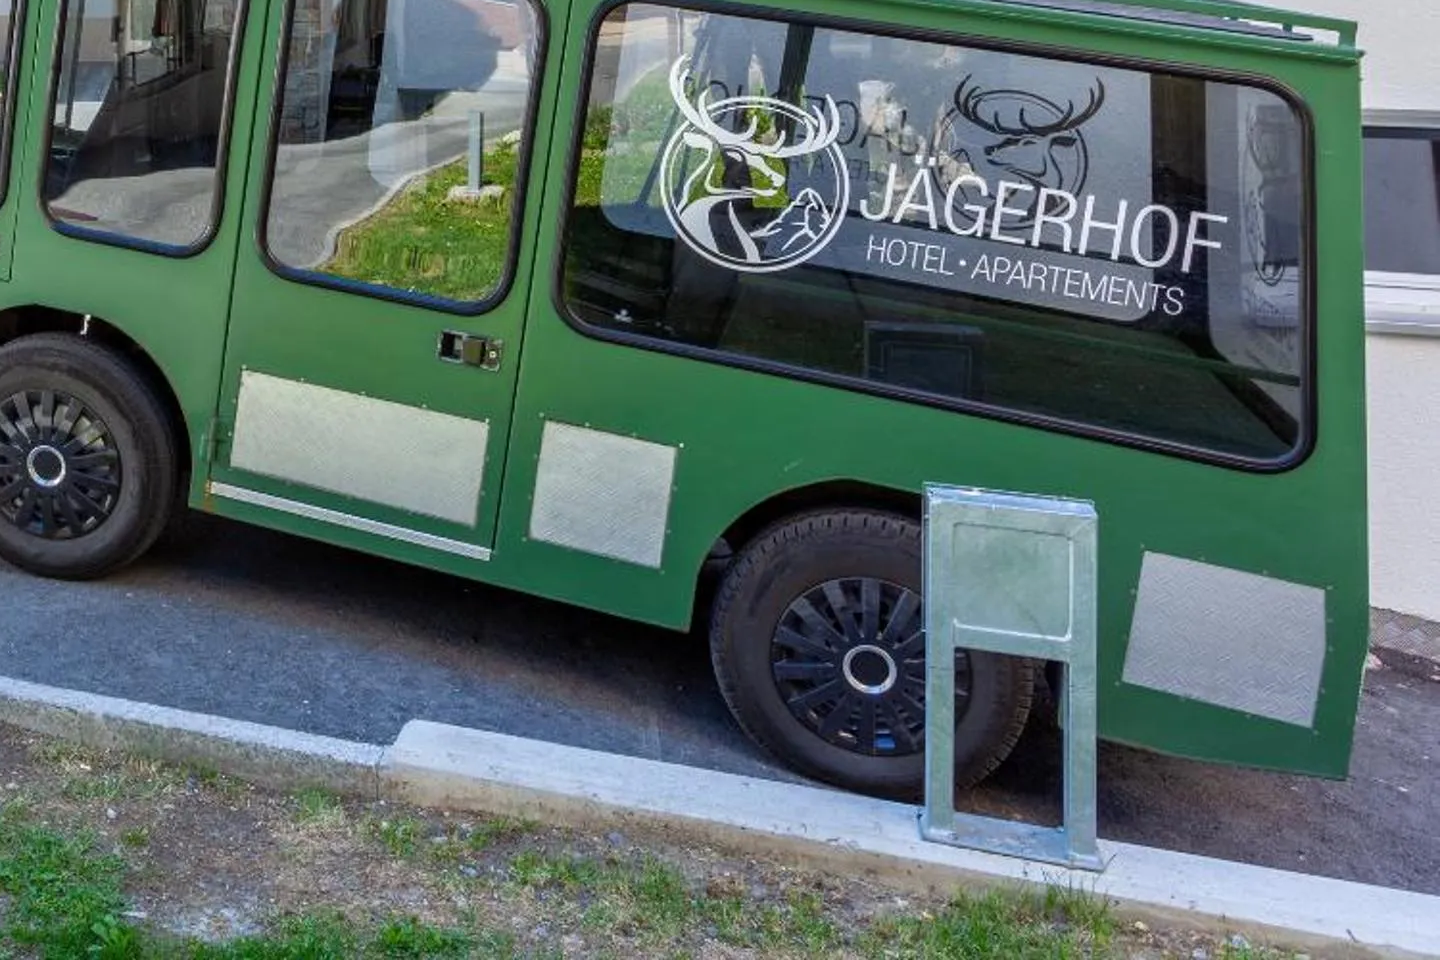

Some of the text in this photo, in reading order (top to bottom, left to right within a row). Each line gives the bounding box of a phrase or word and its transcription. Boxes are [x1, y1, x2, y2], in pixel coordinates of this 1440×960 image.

[859, 154, 1229, 274] JÄGERHOF
[867, 233, 1186, 316] HOTEL APARTEMENTS
